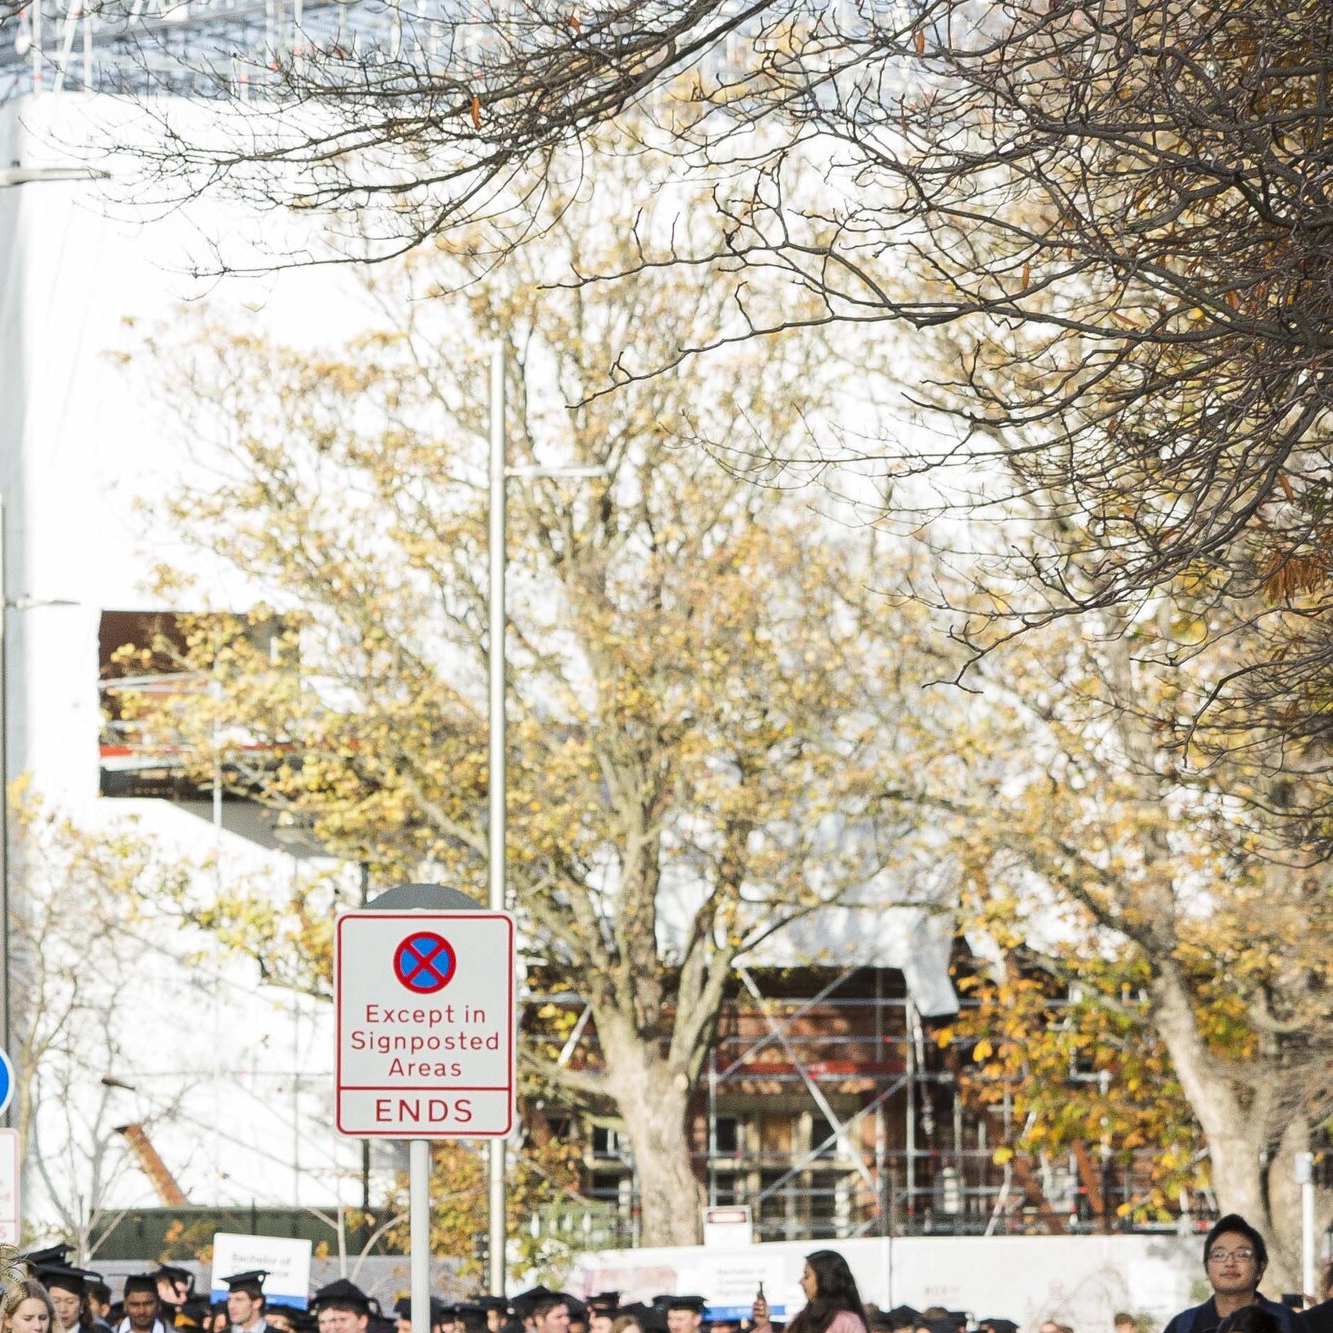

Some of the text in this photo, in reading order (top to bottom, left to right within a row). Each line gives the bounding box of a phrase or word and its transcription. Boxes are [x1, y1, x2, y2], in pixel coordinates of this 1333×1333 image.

[366, 1004, 486, 1027] Except in
[351, 1031, 499, 1054] Signposted
[388, 1058, 462, 1077] Areas
[375, 1099, 473, 1123] ENDS
